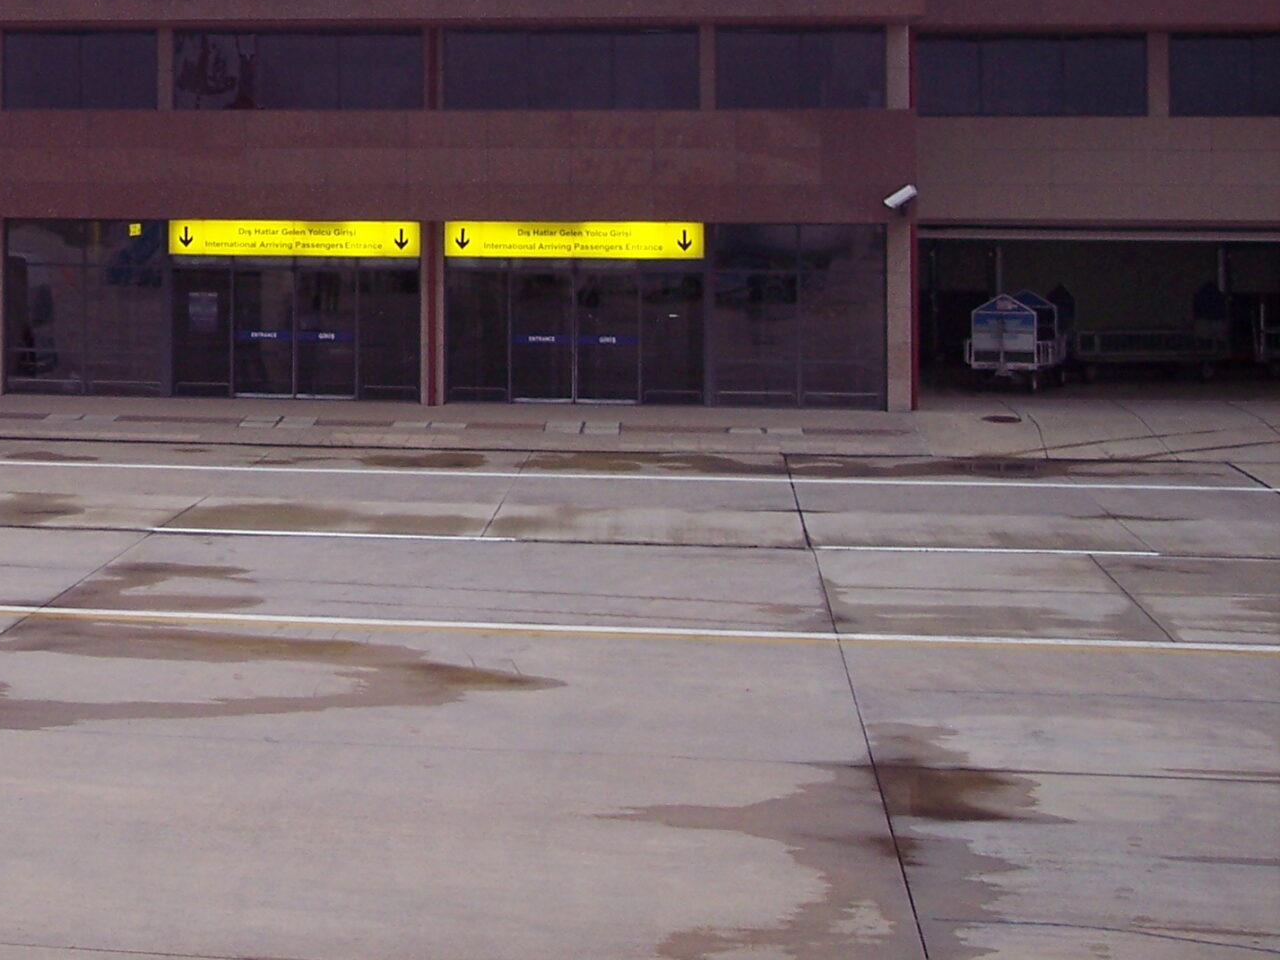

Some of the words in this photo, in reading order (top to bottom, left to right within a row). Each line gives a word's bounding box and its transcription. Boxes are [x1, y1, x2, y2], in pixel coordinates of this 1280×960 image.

[254, 227, 279, 236] Hatlar
[281, 227, 306, 236] Gelen
[559, 228, 583, 237] Gelen
[205, 240, 257, 249] International
[259, 241, 293, 250] Arriving
[295, 241, 344, 251] Passengers
[345, 242, 383, 250] Entrance
[483, 241, 536, 250] International
[538, 242, 572, 251] Arriving
[573, 242, 624, 252] Passengers
[625, 243, 664, 251] Entrance
